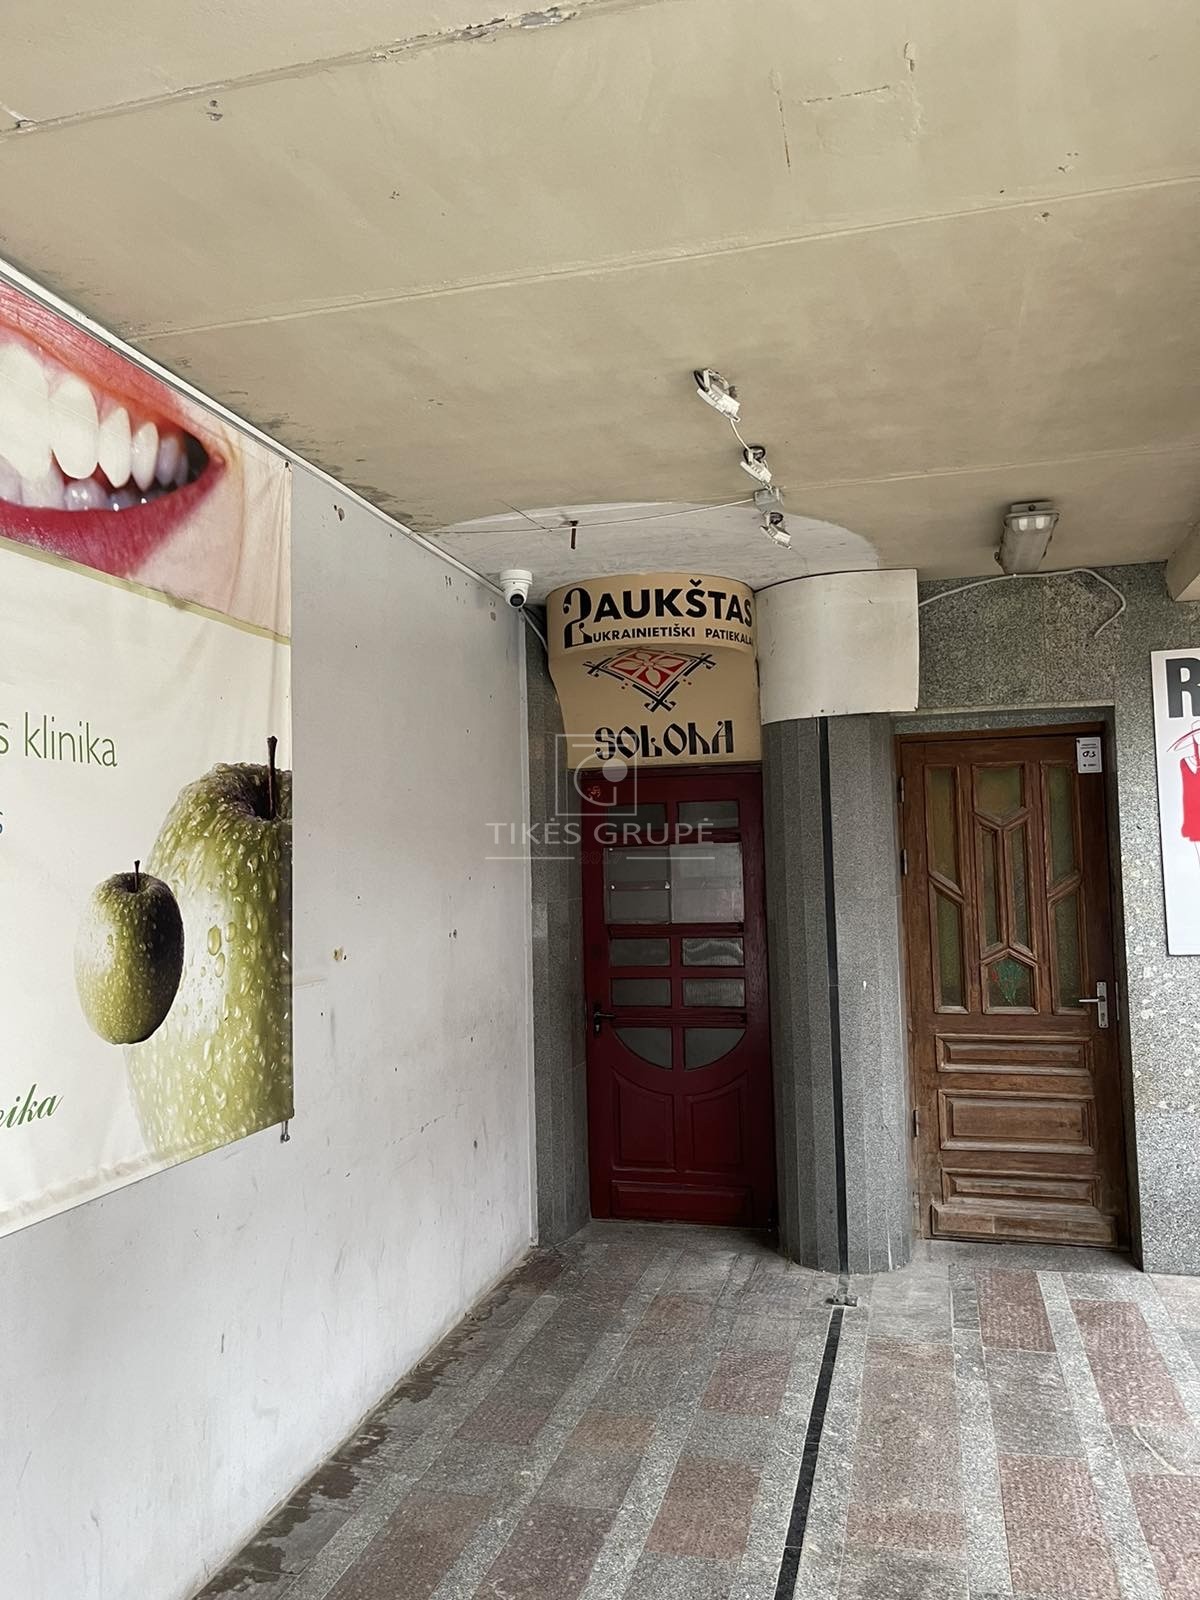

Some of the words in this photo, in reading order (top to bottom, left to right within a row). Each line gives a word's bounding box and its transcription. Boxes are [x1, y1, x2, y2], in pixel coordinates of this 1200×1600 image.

[563, 587, 593, 649] 2
[593, 579, 752, 627] AUKŠTAS
[593, 624, 695, 643] UKRAINIETIŠKI
[1166, 657, 1200, 719] R
[25, 711, 118, 767] klinika
